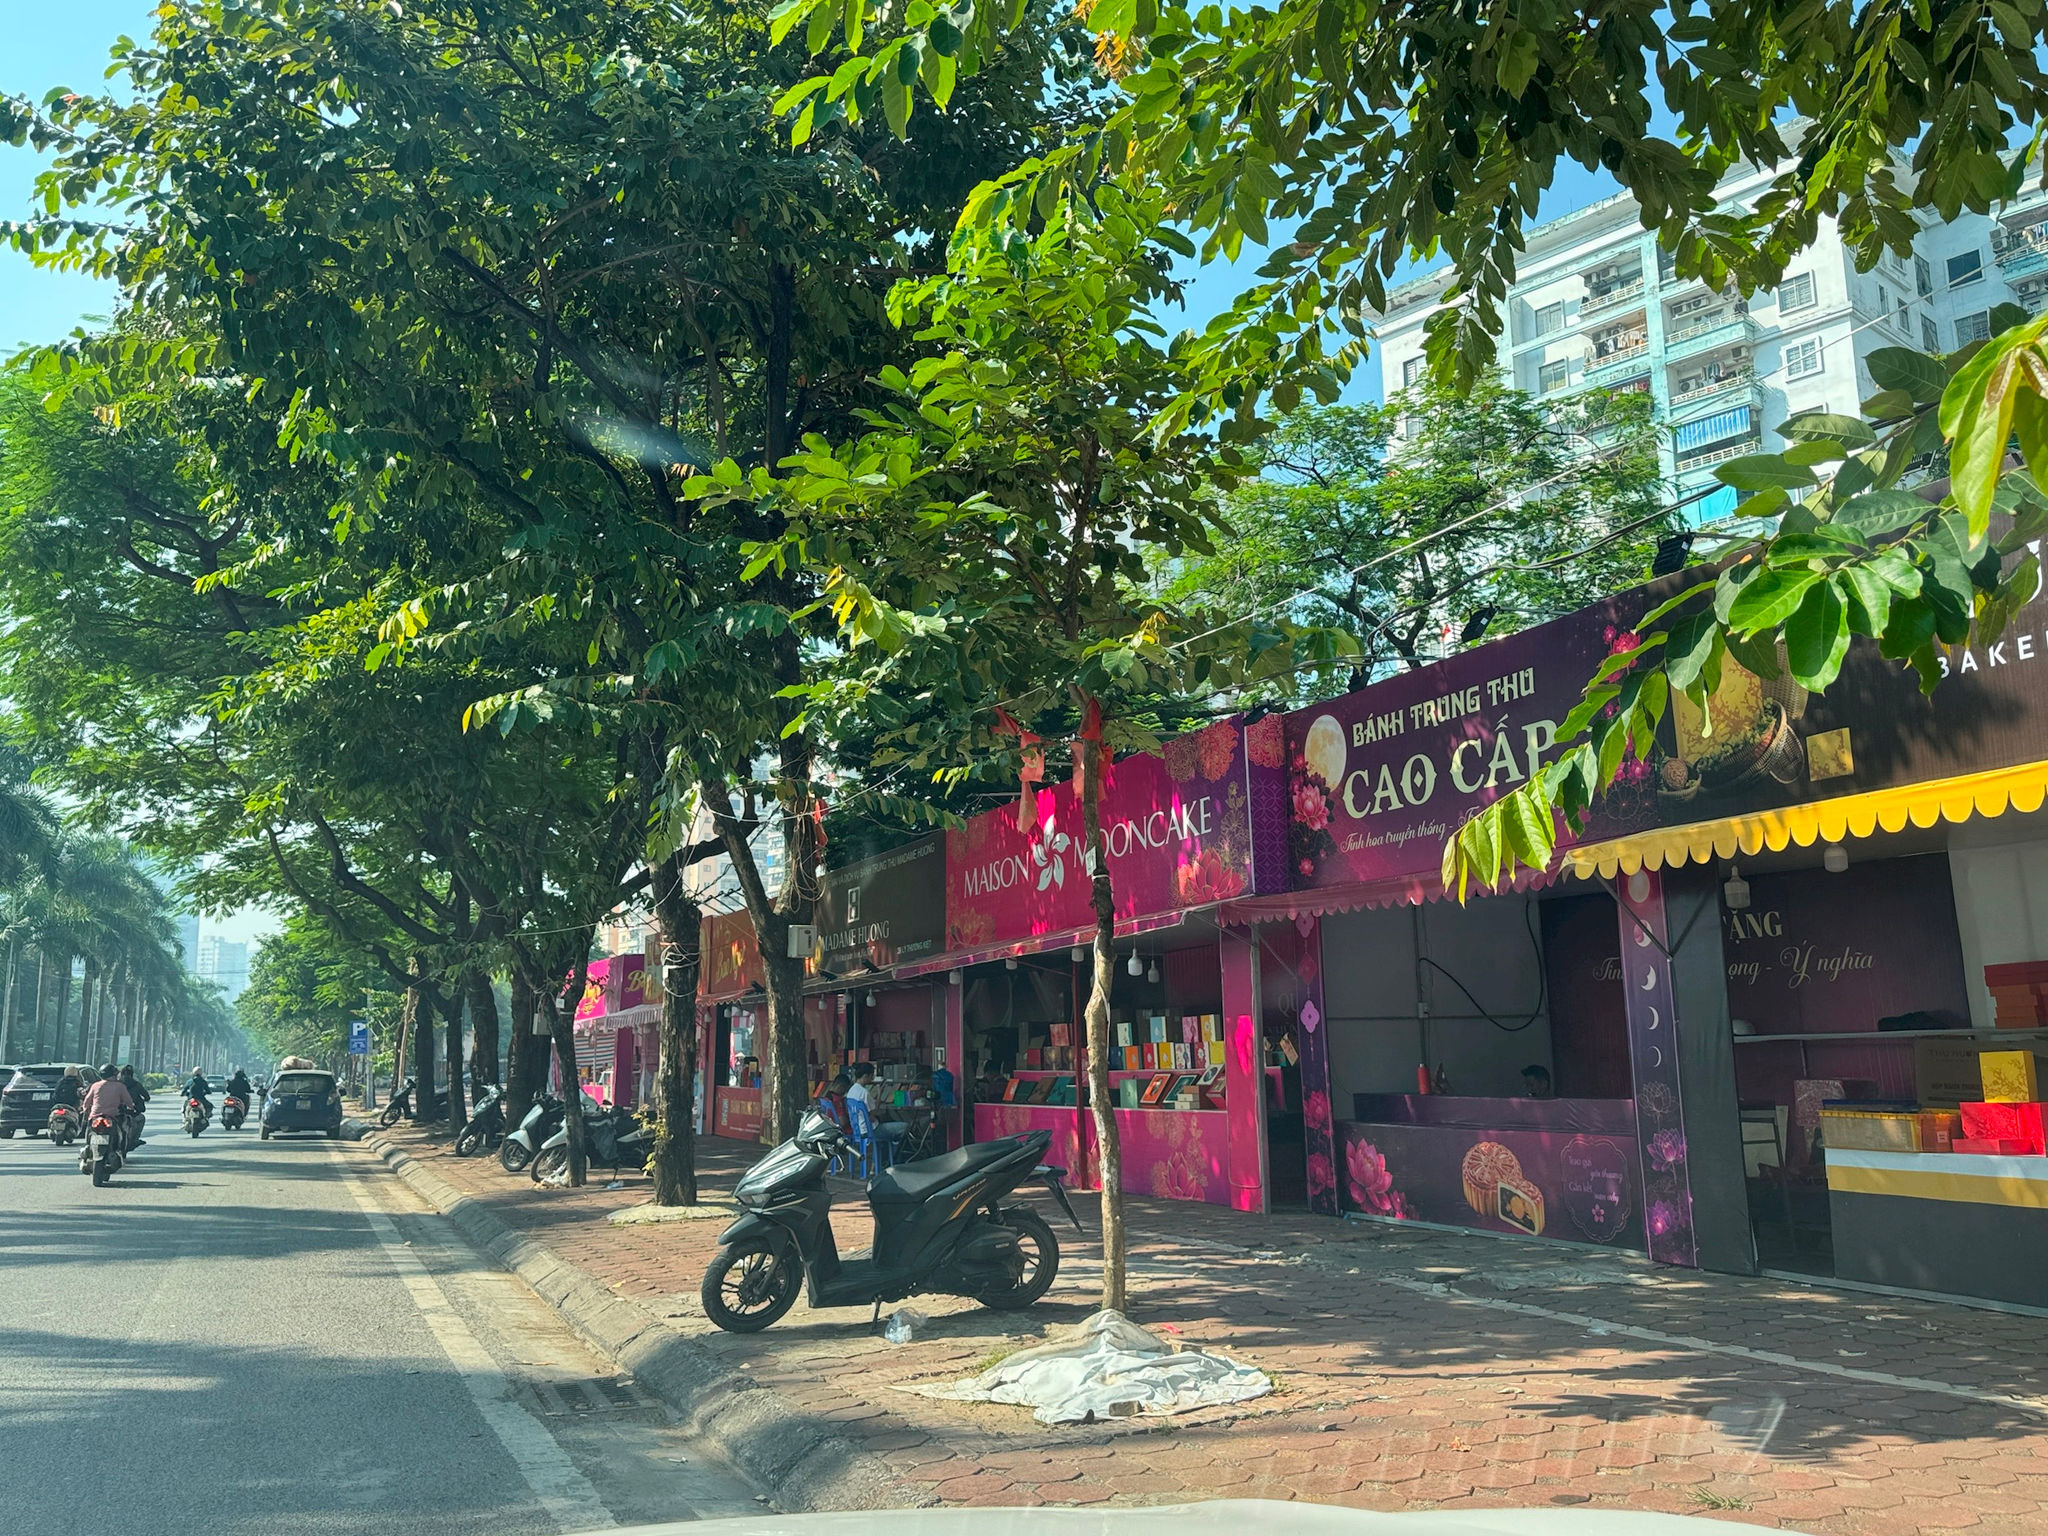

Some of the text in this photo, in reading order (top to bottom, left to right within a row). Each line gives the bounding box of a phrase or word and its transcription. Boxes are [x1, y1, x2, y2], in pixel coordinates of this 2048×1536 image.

[1937, 629, 2048, 679] BAKE
[1352, 667, 1536, 748] BÁNH TRUNG THU
[1342, 713, 1558, 819] CAO CẤP
[1340, 831, 1365, 853] Tinh
[1365, 830, 1384, 848] hoa
[1384, 824, 1416, 848] truyền
[1416, 818, 1447, 841] thống
[963, 850, 1030, 898] MAISON
[823, 928, 857, 952] MADAME
[1722, 909, 1783, 945] ẶNG
[1780, 940, 1817, 989] Ý
[1816, 951, 1874, 982] nghĩa
[352, 1022, 367, 1036] P
